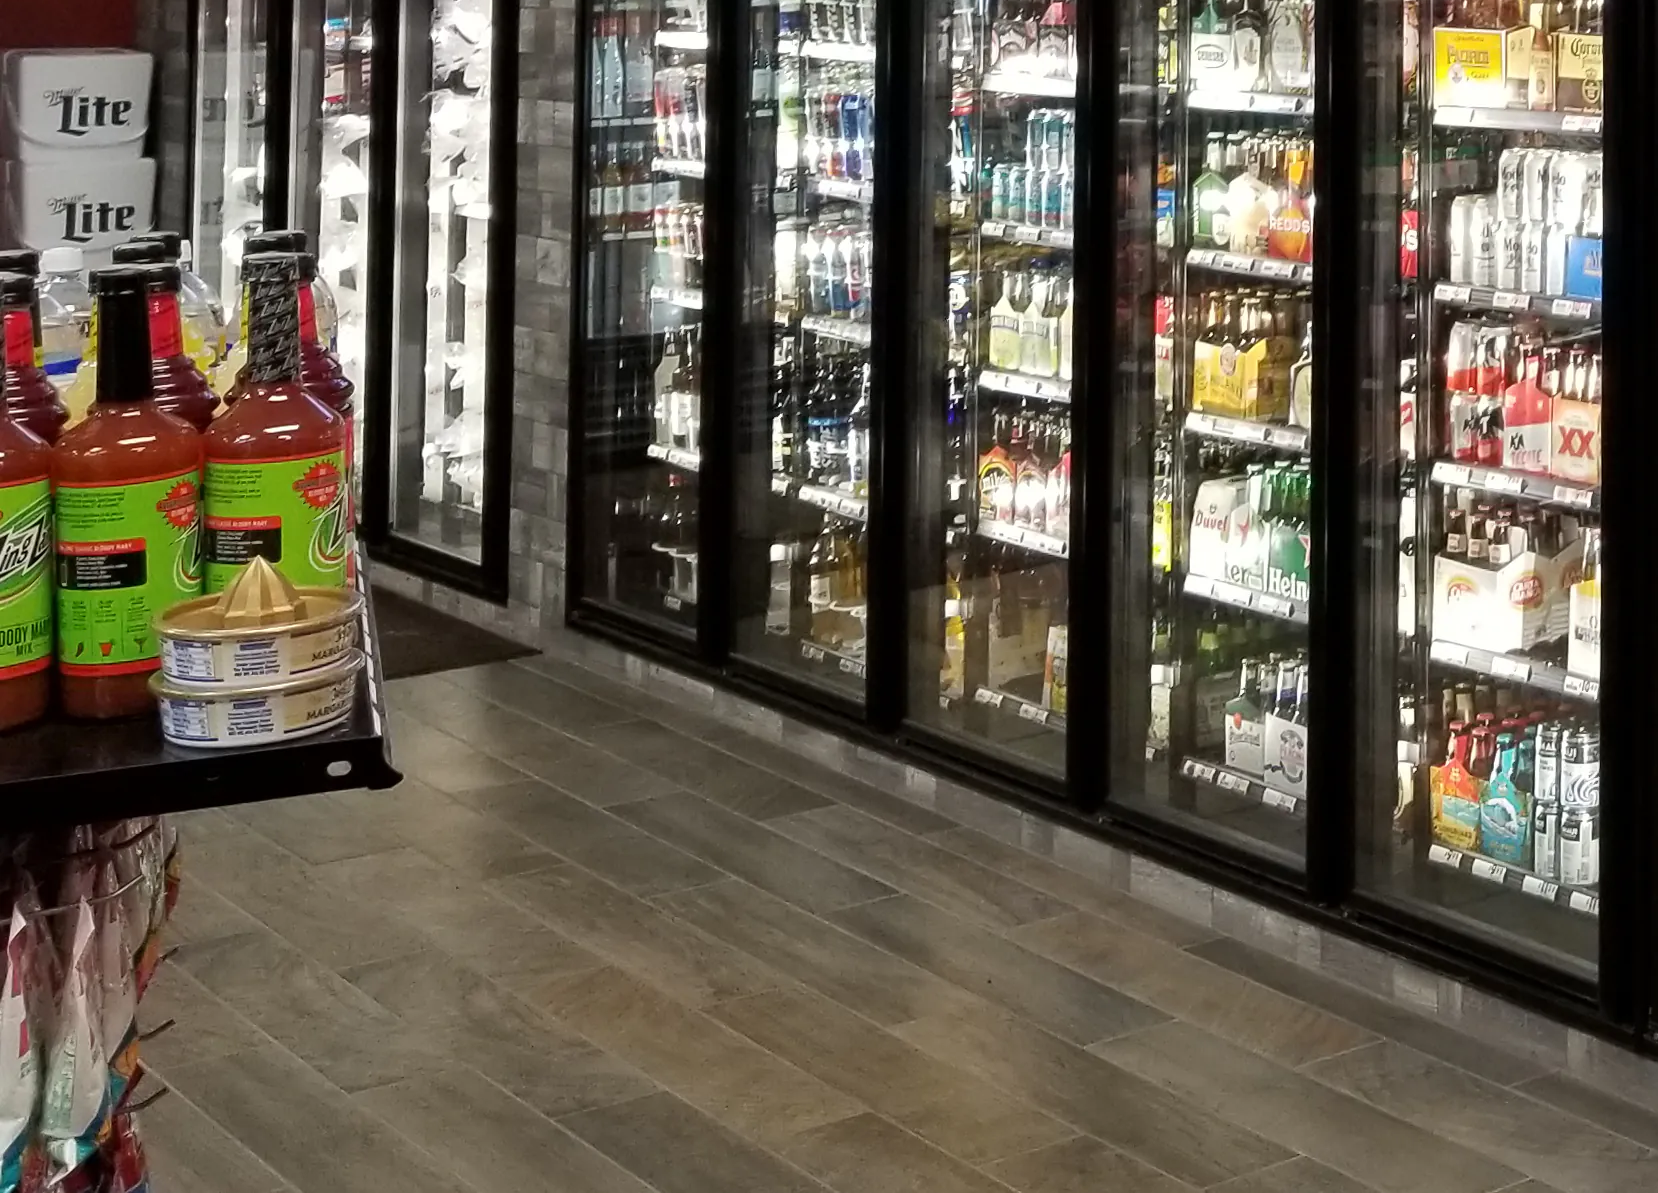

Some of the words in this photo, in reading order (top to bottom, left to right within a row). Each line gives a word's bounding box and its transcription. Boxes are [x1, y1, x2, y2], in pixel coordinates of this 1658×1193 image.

[1570, 38, 1603, 57] Coron
[57, 94, 132, 136] Lite
[61, 201, 136, 243] Lite
[1559, 425, 1595, 460] XX
[1195, 509, 1228, 532] Duvel
[1269, 567, 1309, 602] Hein
